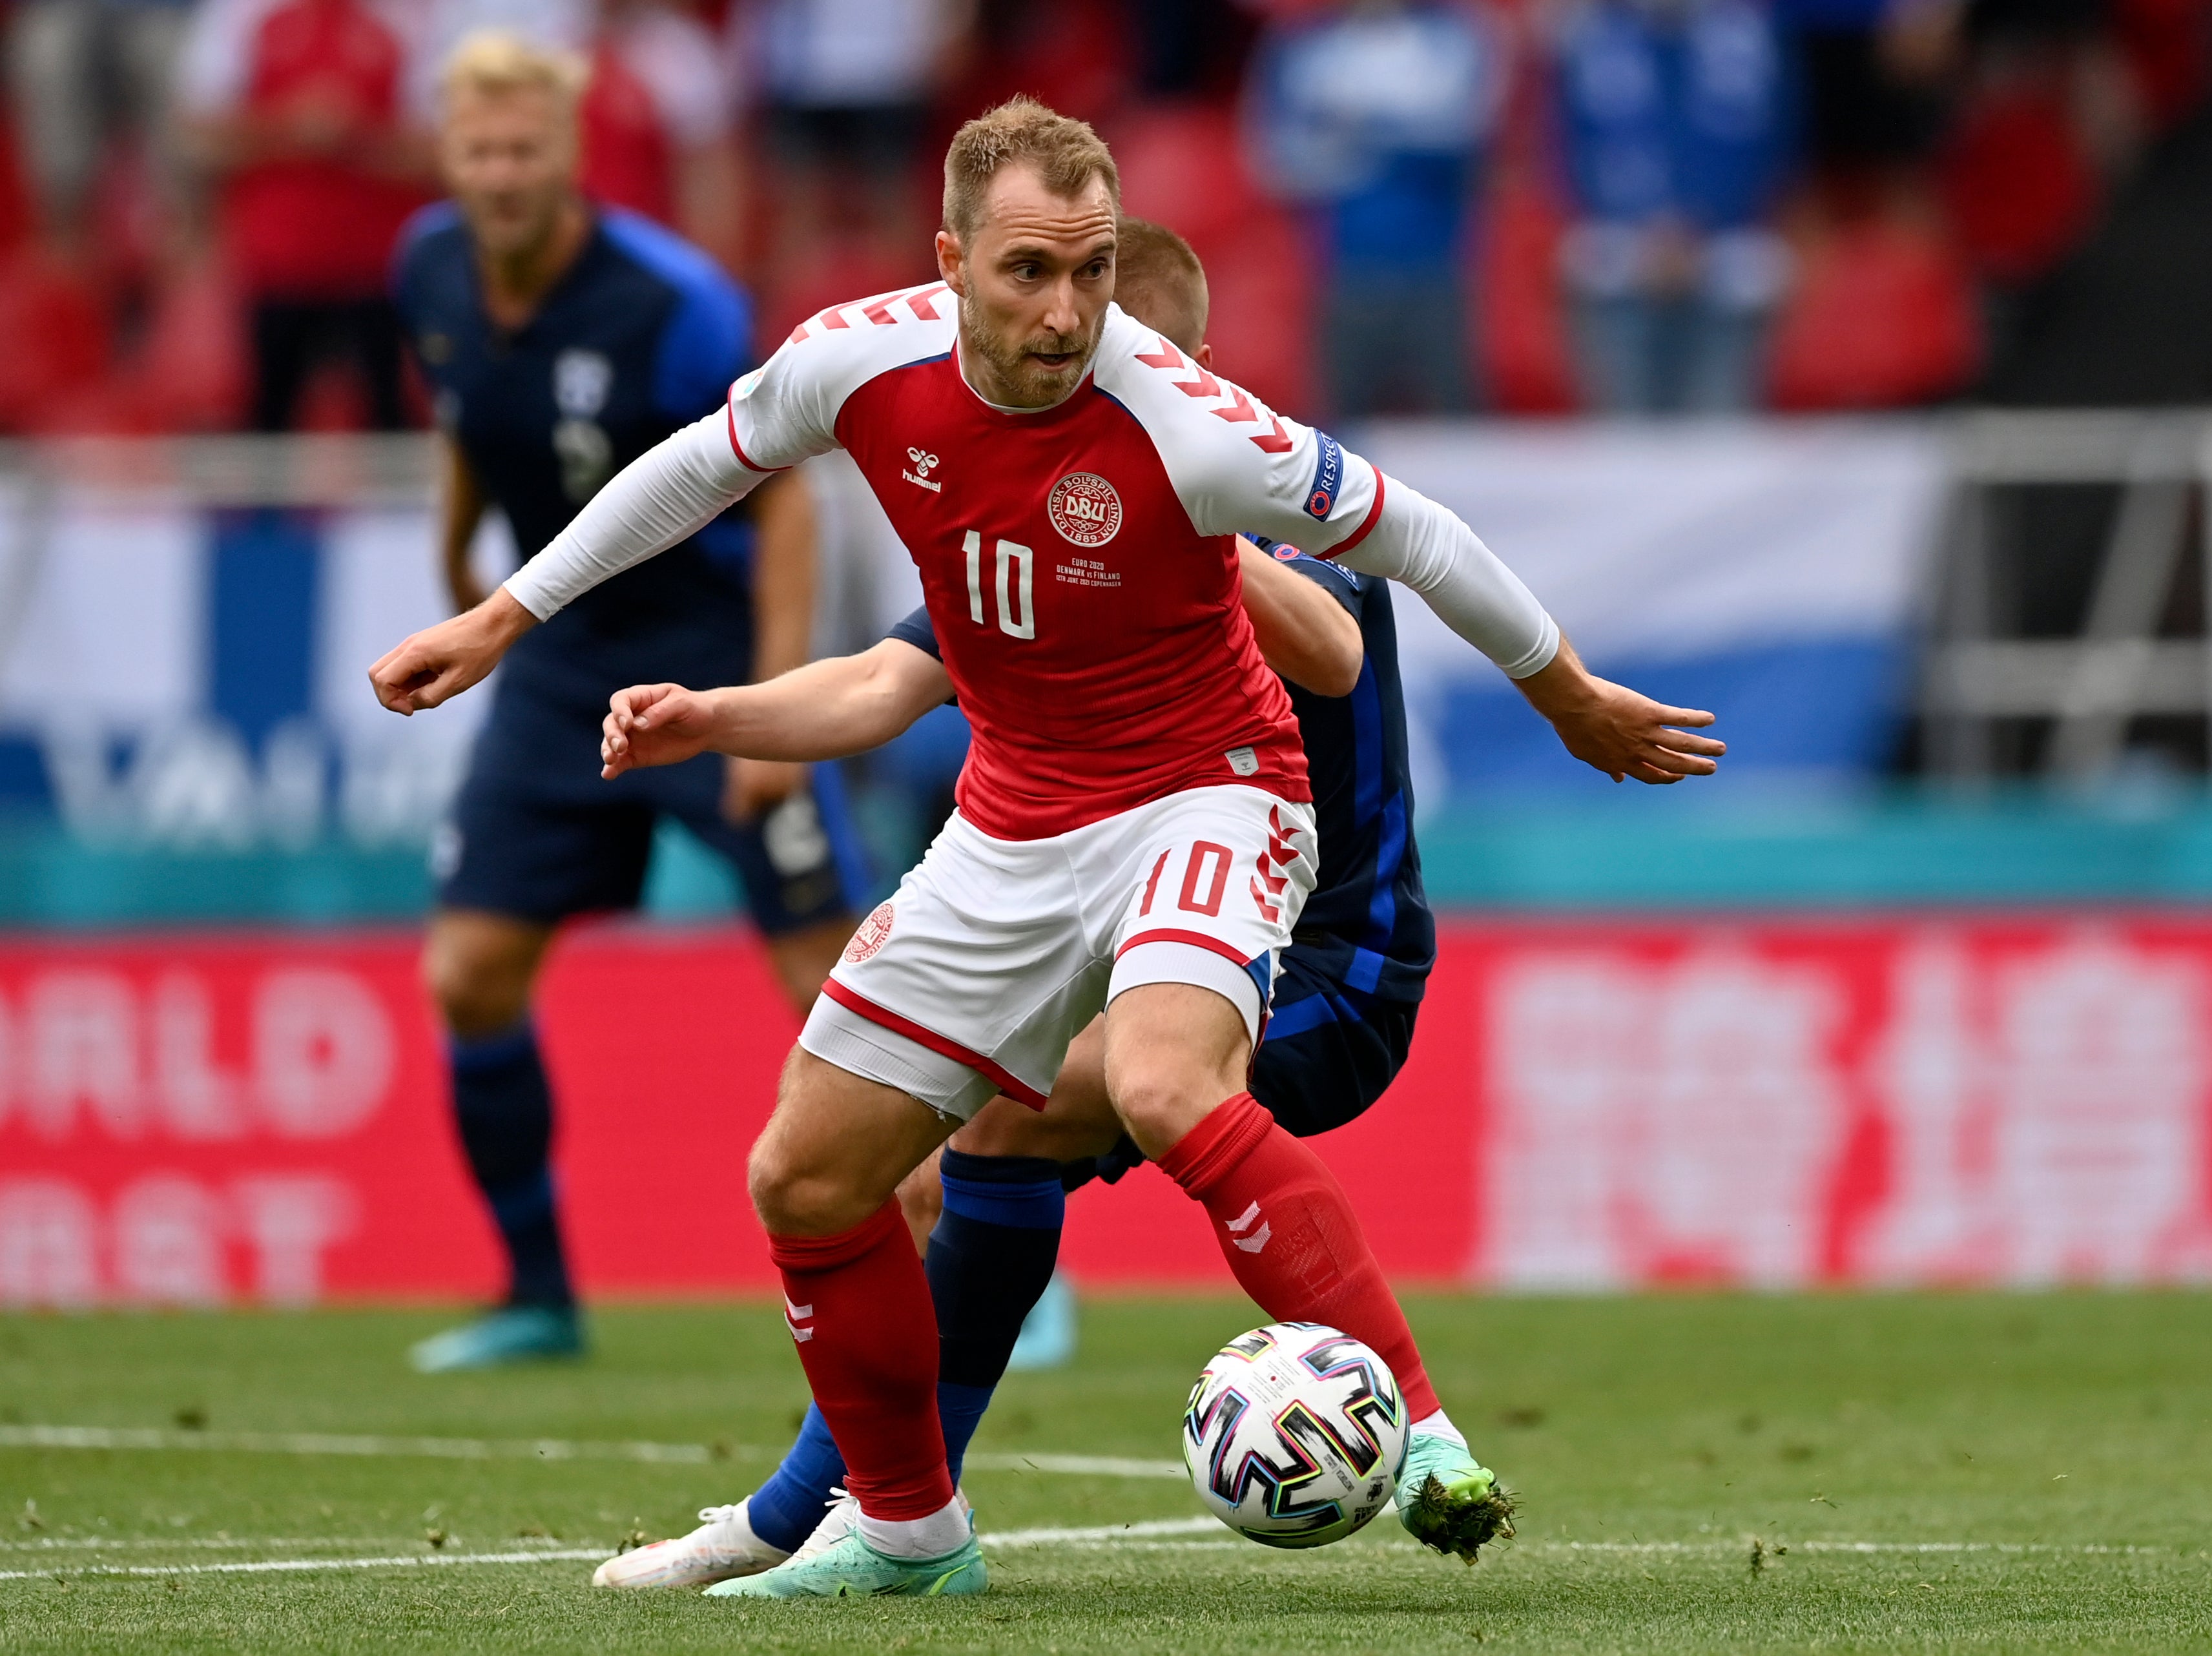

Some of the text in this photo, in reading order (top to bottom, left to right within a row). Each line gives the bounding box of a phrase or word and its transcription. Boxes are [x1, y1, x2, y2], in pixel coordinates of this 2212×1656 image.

[902, 468, 942, 493] hummel
[1052, 488, 1067, 530] DANSK
[1064, 495, 1106, 522] DBU
[1069, 531, 1097, 543] 1889
[1057, 564, 1085, 577] DENMARK
[1093, 571, 1121, 580] FINLAND
[1072, 557, 1104, 570] EURO 2020
[962, 530, 1035, 640] 10
[1139, 840, 1233, 917] 10
[0, 966, 395, 1142] RLD
